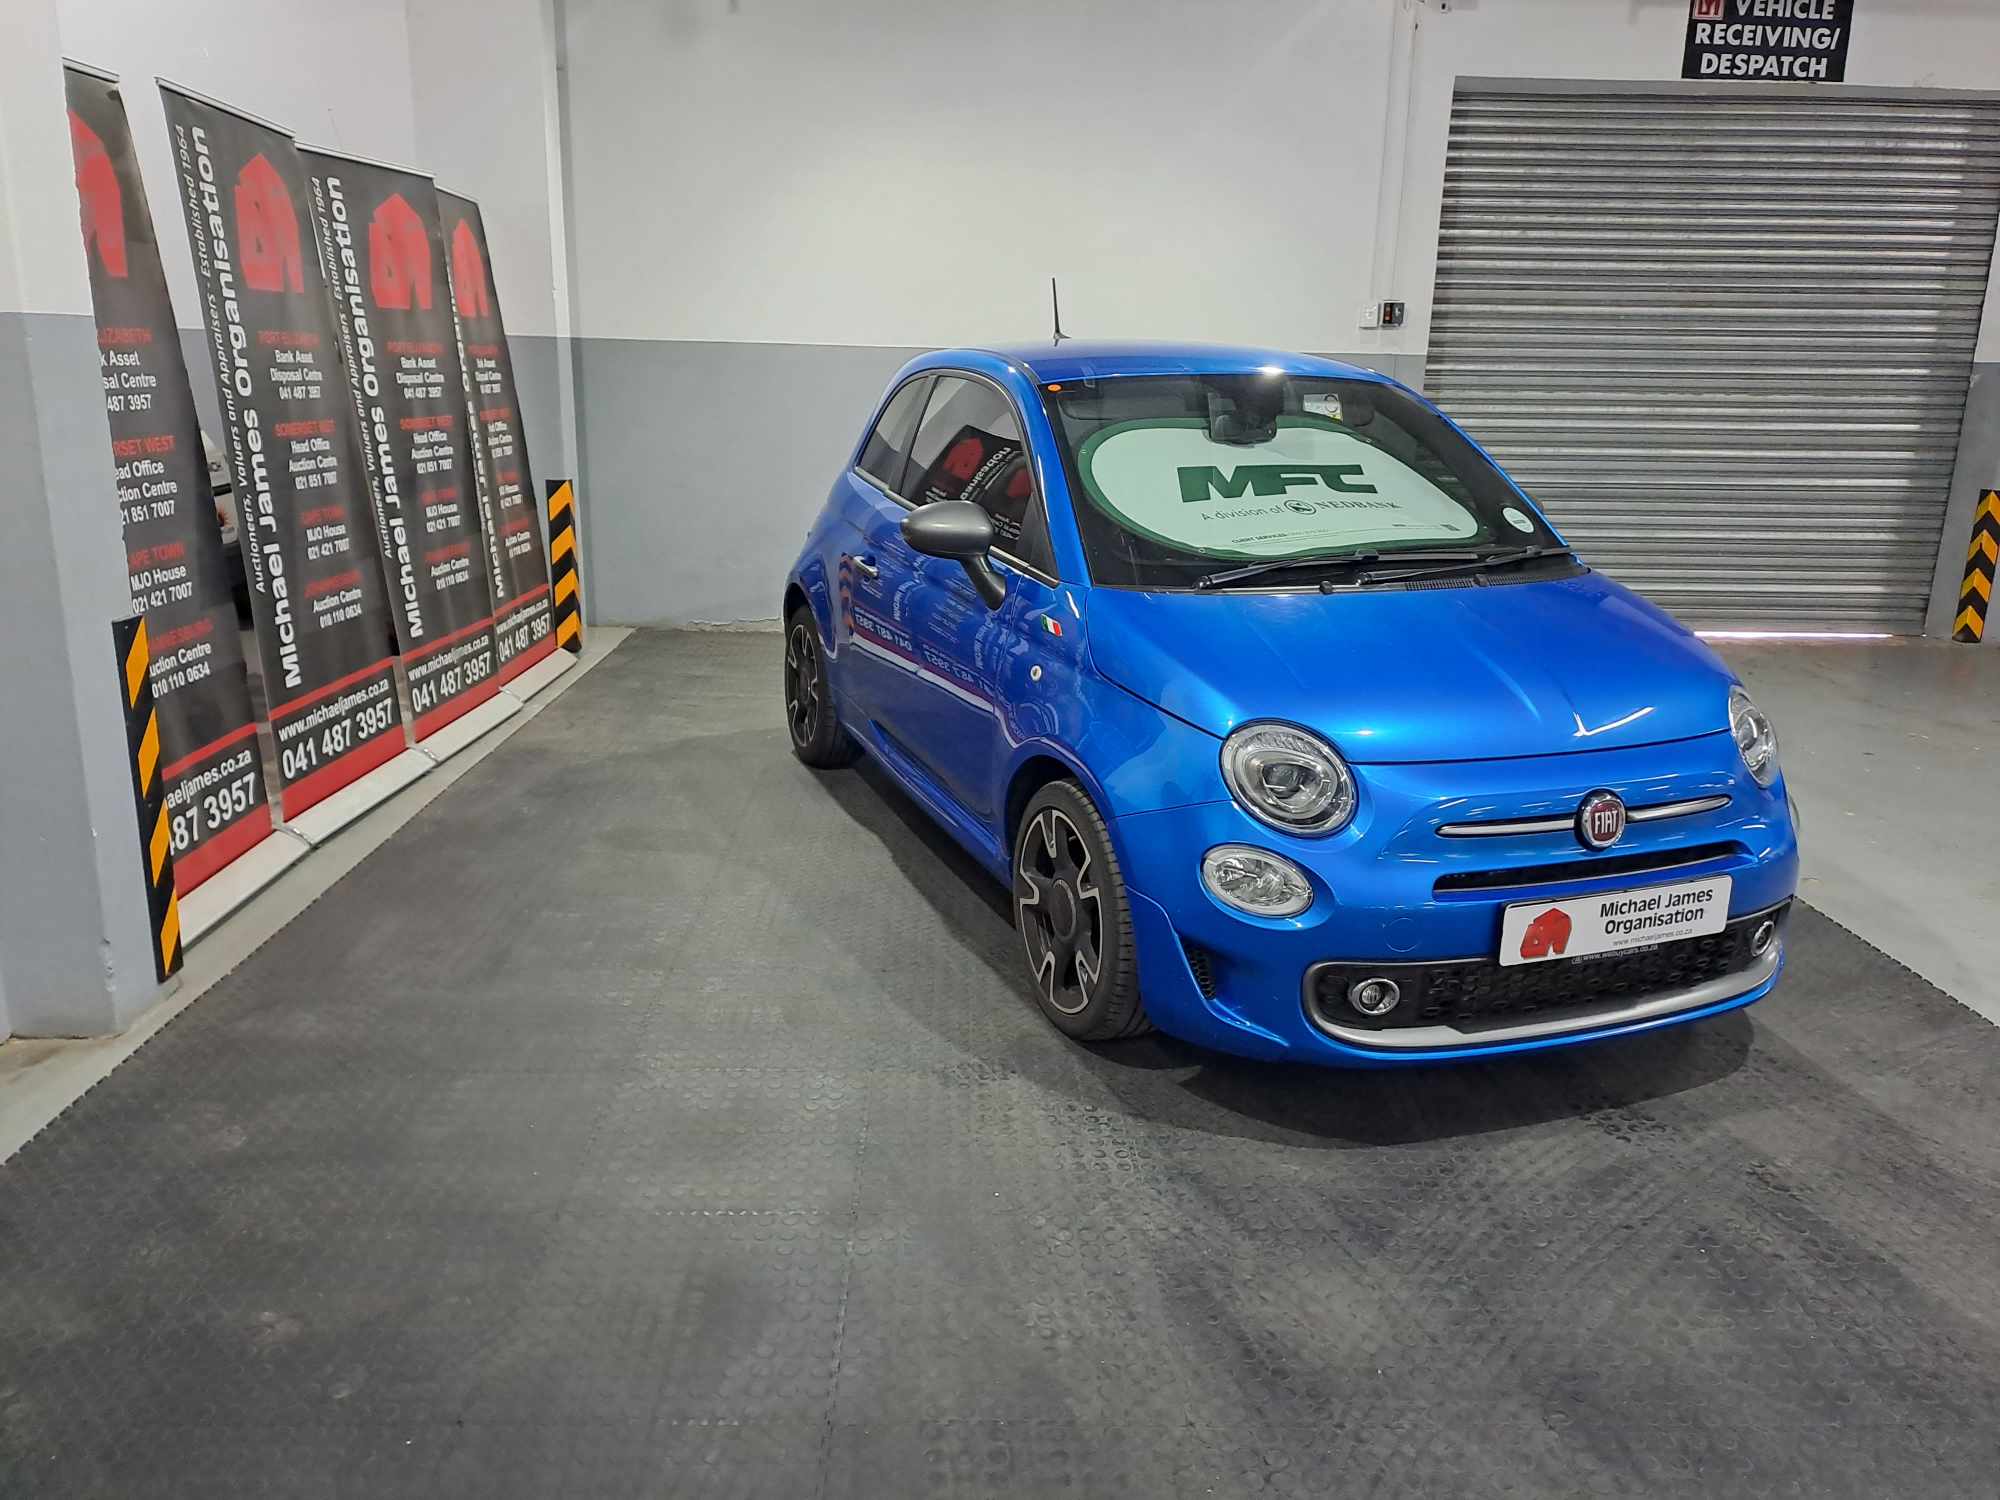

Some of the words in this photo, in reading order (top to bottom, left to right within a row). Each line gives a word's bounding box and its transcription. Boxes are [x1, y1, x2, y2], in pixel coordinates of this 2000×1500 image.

[1736, 0, 1835, 20] VEHICLE
[1695, 23, 1841, 50] RECEIVING/
[1700, 53, 1827, 78] DESPATCH
[175, 124, 193, 172] 1964
[312, 177, 327, 214] 1964
[186, 175, 211, 278] Established
[192, 126, 252, 397] Organisation
[319, 216, 343, 300] Established
[327, 176, 379, 397] Organisation
[110, 350, 141, 366] Asset
[207, 293, 232, 385] Appraisers
[339, 312, 360, 392] Appraisers
[120, 372, 157, 388] Centre
[128, 394, 152, 411] 3957
[222, 388, 237, 421] and
[353, 394, 366, 418] and
[115, 464, 131, 480] ead
[132, 460, 165, 478] Office
[231, 426, 248, 487] Valuers
[243, 409, 277, 533] James
[371, 406, 400, 509] James
[142, 480, 178, 498] Centre
[1177, 464, 1378, 503] MFC
[131, 505, 150, 523] 851
[151, 500, 175, 518] 7007
[1201, 513, 1213, 521] A
[1215, 507, 1268, 520] division
[1271, 504, 1286, 514] of
[1314, 500, 1403, 510] NEDBANK
[130, 573, 152, 592] MJO
[153, 565, 187, 586] House
[389, 517, 424, 639] Michael
[132, 596, 149, 614] 021
[150, 588, 167, 608] 421
[169, 582, 193, 602] 7007
[263, 543, 302, 689] Michael
[499, 634, 514, 662] 041
[515, 624, 528, 650] 487
[531, 612, 550, 641] 3957
[149, 653, 178, 677] uction
[178, 642, 212, 664] Centre
[152, 679, 168, 699] 010
[168, 671, 185, 690] 110
[187, 661, 211, 684] 0634
[411, 679, 437, 713] 041
[439, 666, 462, 698] 487
[463, 650, 491, 686] 3957
[278, 678, 389, 742] www.michaeljames.co.za
[282, 737, 317, 780] 041
[321, 718, 352, 757] 487
[356, 697, 393, 740] 3957
[166, 748, 253, 809] aeljames.co.za
[171, 805, 200, 855] 87
[204, 771, 256, 829] 3957
[1594, 809, 1618, 835] FIAT
[1600, 894, 1661, 918] Michael
[1665, 889, 1713, 908] James
[1605, 907, 1704, 935] Organisation
